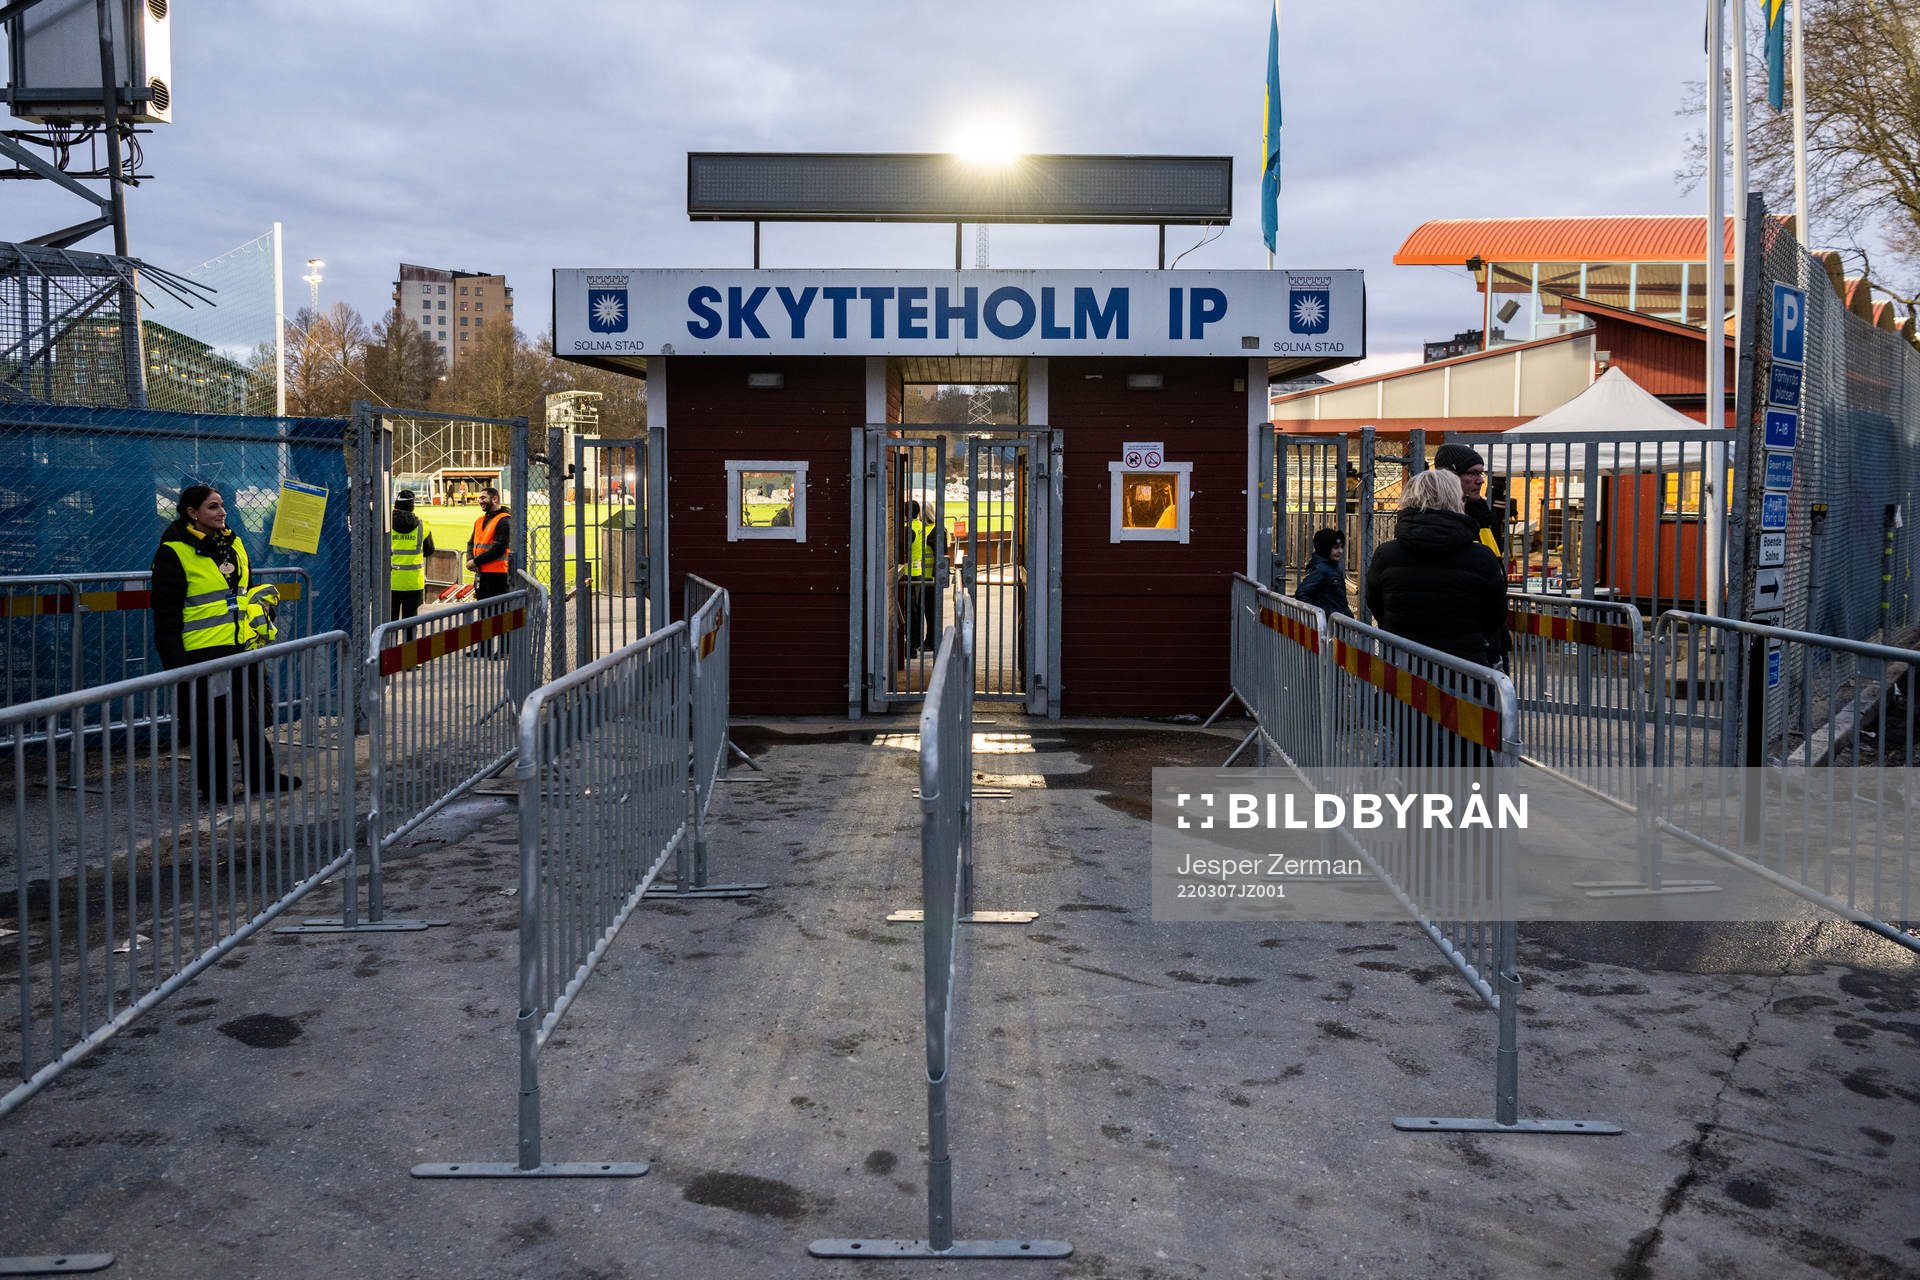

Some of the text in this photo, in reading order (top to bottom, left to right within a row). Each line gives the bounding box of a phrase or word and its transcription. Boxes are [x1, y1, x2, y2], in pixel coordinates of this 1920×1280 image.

[686, 286, 1228, 340] SKYTTEHOLM IP
[1781, 293, 1799, 354] P
[574, 340, 645, 351] SOLNA STAD
[1272, 341, 1345, 352] SOLNA STAD
[1774, 388, 1795, 402] platser
[1775, 422, 1789, 436] 7-18
[1763, 536, 1782, 547] Boende
[1764, 550, 1780, 561] Solna
